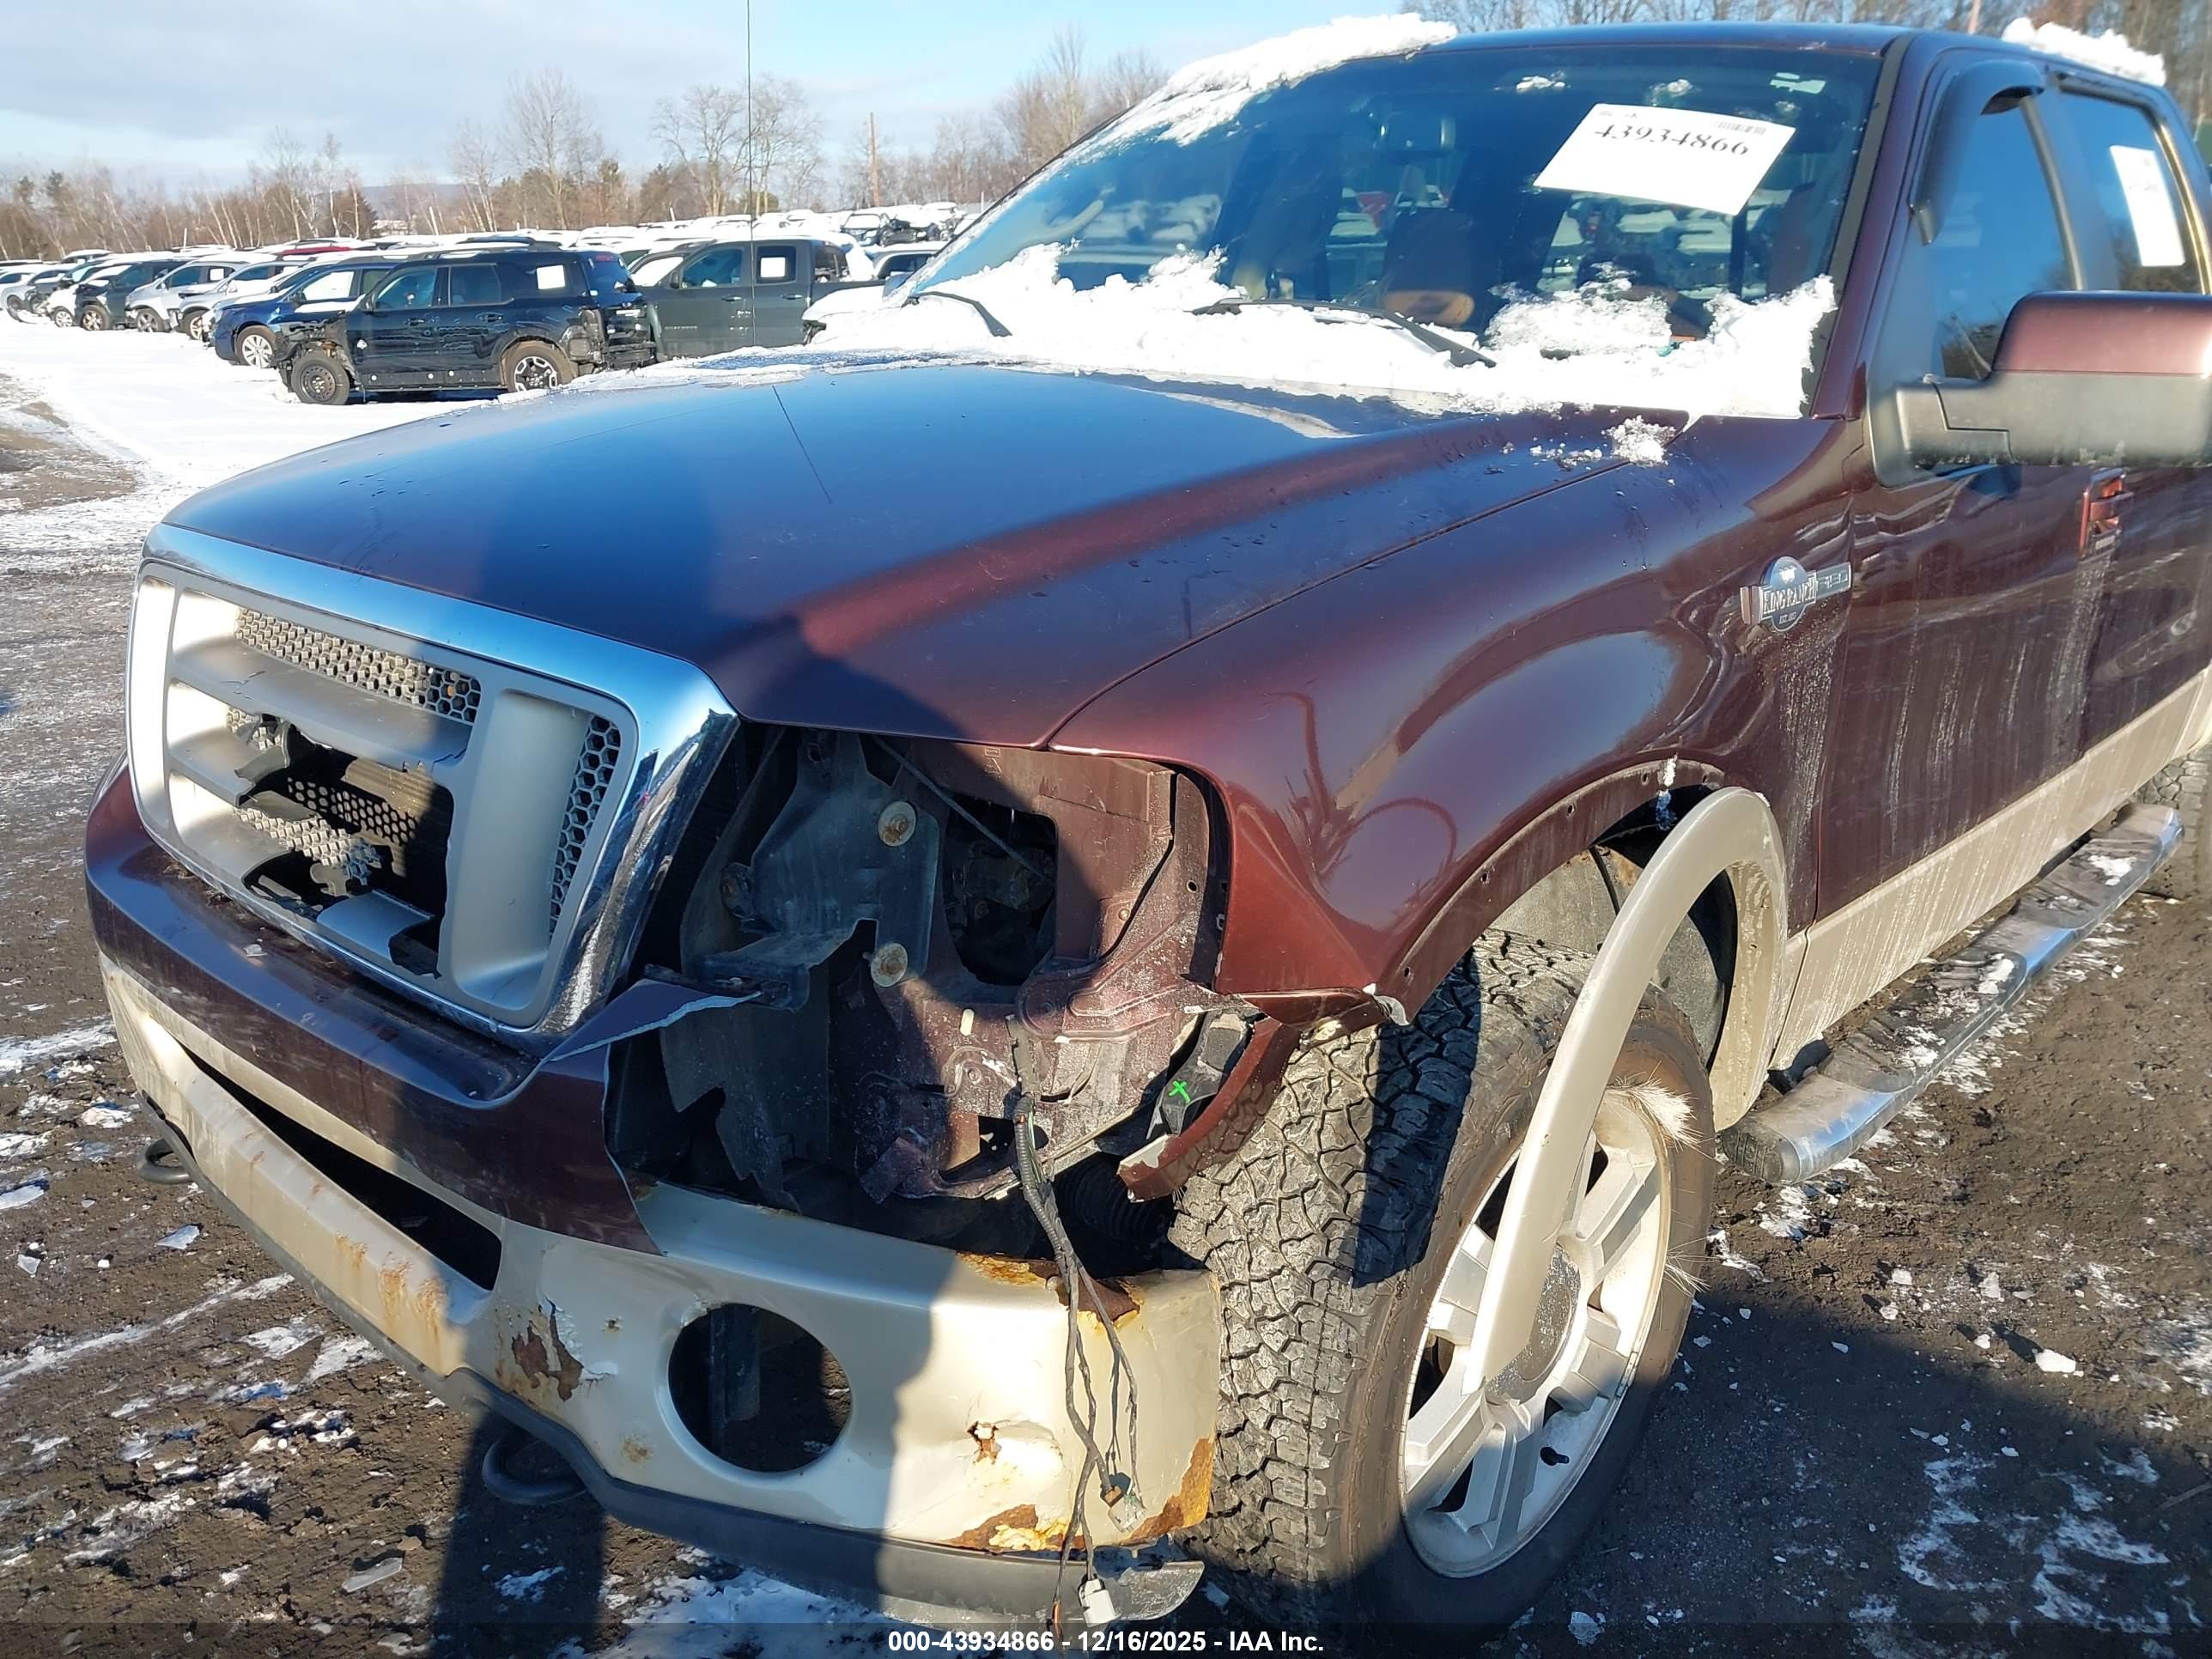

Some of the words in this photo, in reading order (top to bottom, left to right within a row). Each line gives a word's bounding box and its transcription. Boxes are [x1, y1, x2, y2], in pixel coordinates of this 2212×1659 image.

[1594, 124, 1749, 156] 43934866
[1763, 587, 1787, 615] KING
[1787, 576, 1816, 607] RANCH
